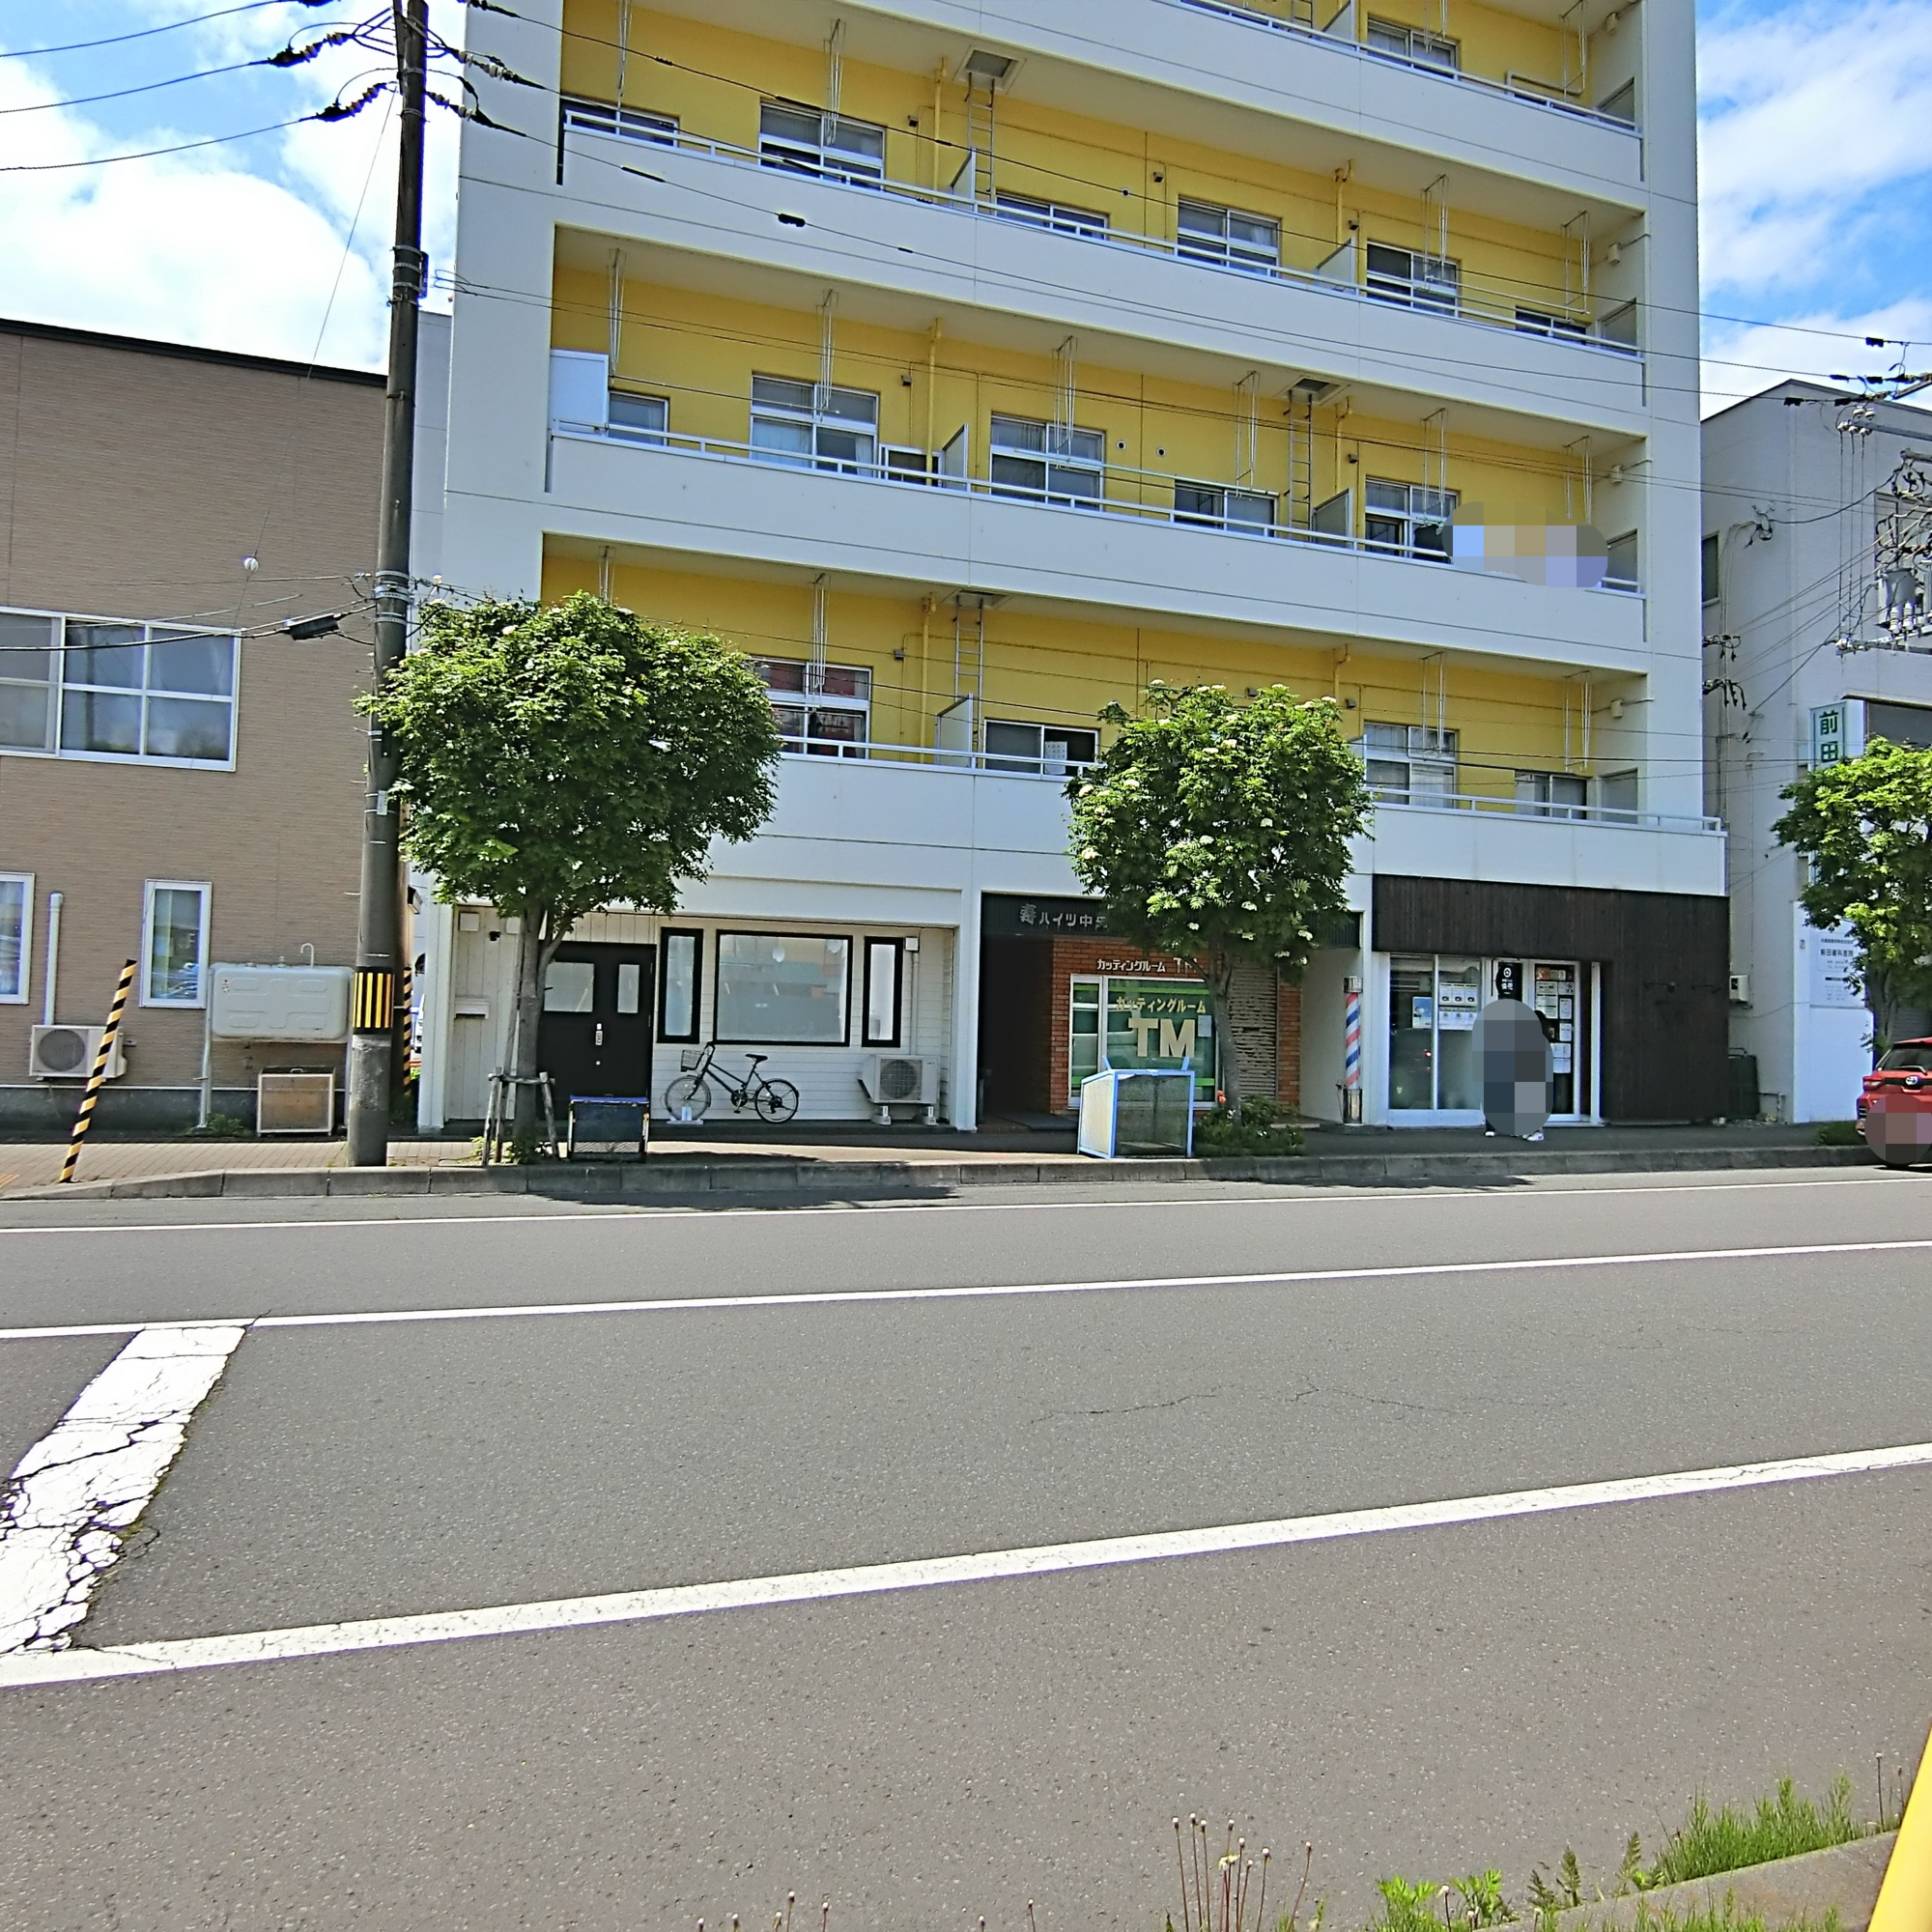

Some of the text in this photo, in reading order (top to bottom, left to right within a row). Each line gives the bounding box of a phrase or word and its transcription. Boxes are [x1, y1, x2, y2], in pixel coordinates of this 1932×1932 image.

[1819, 709, 1839, 763] 前田
[1096, 958, 1166, 973] カッティングルーム
[1117, 996, 1207, 1014] カッティングルーム
[1128, 1017, 1196, 1058] TM
